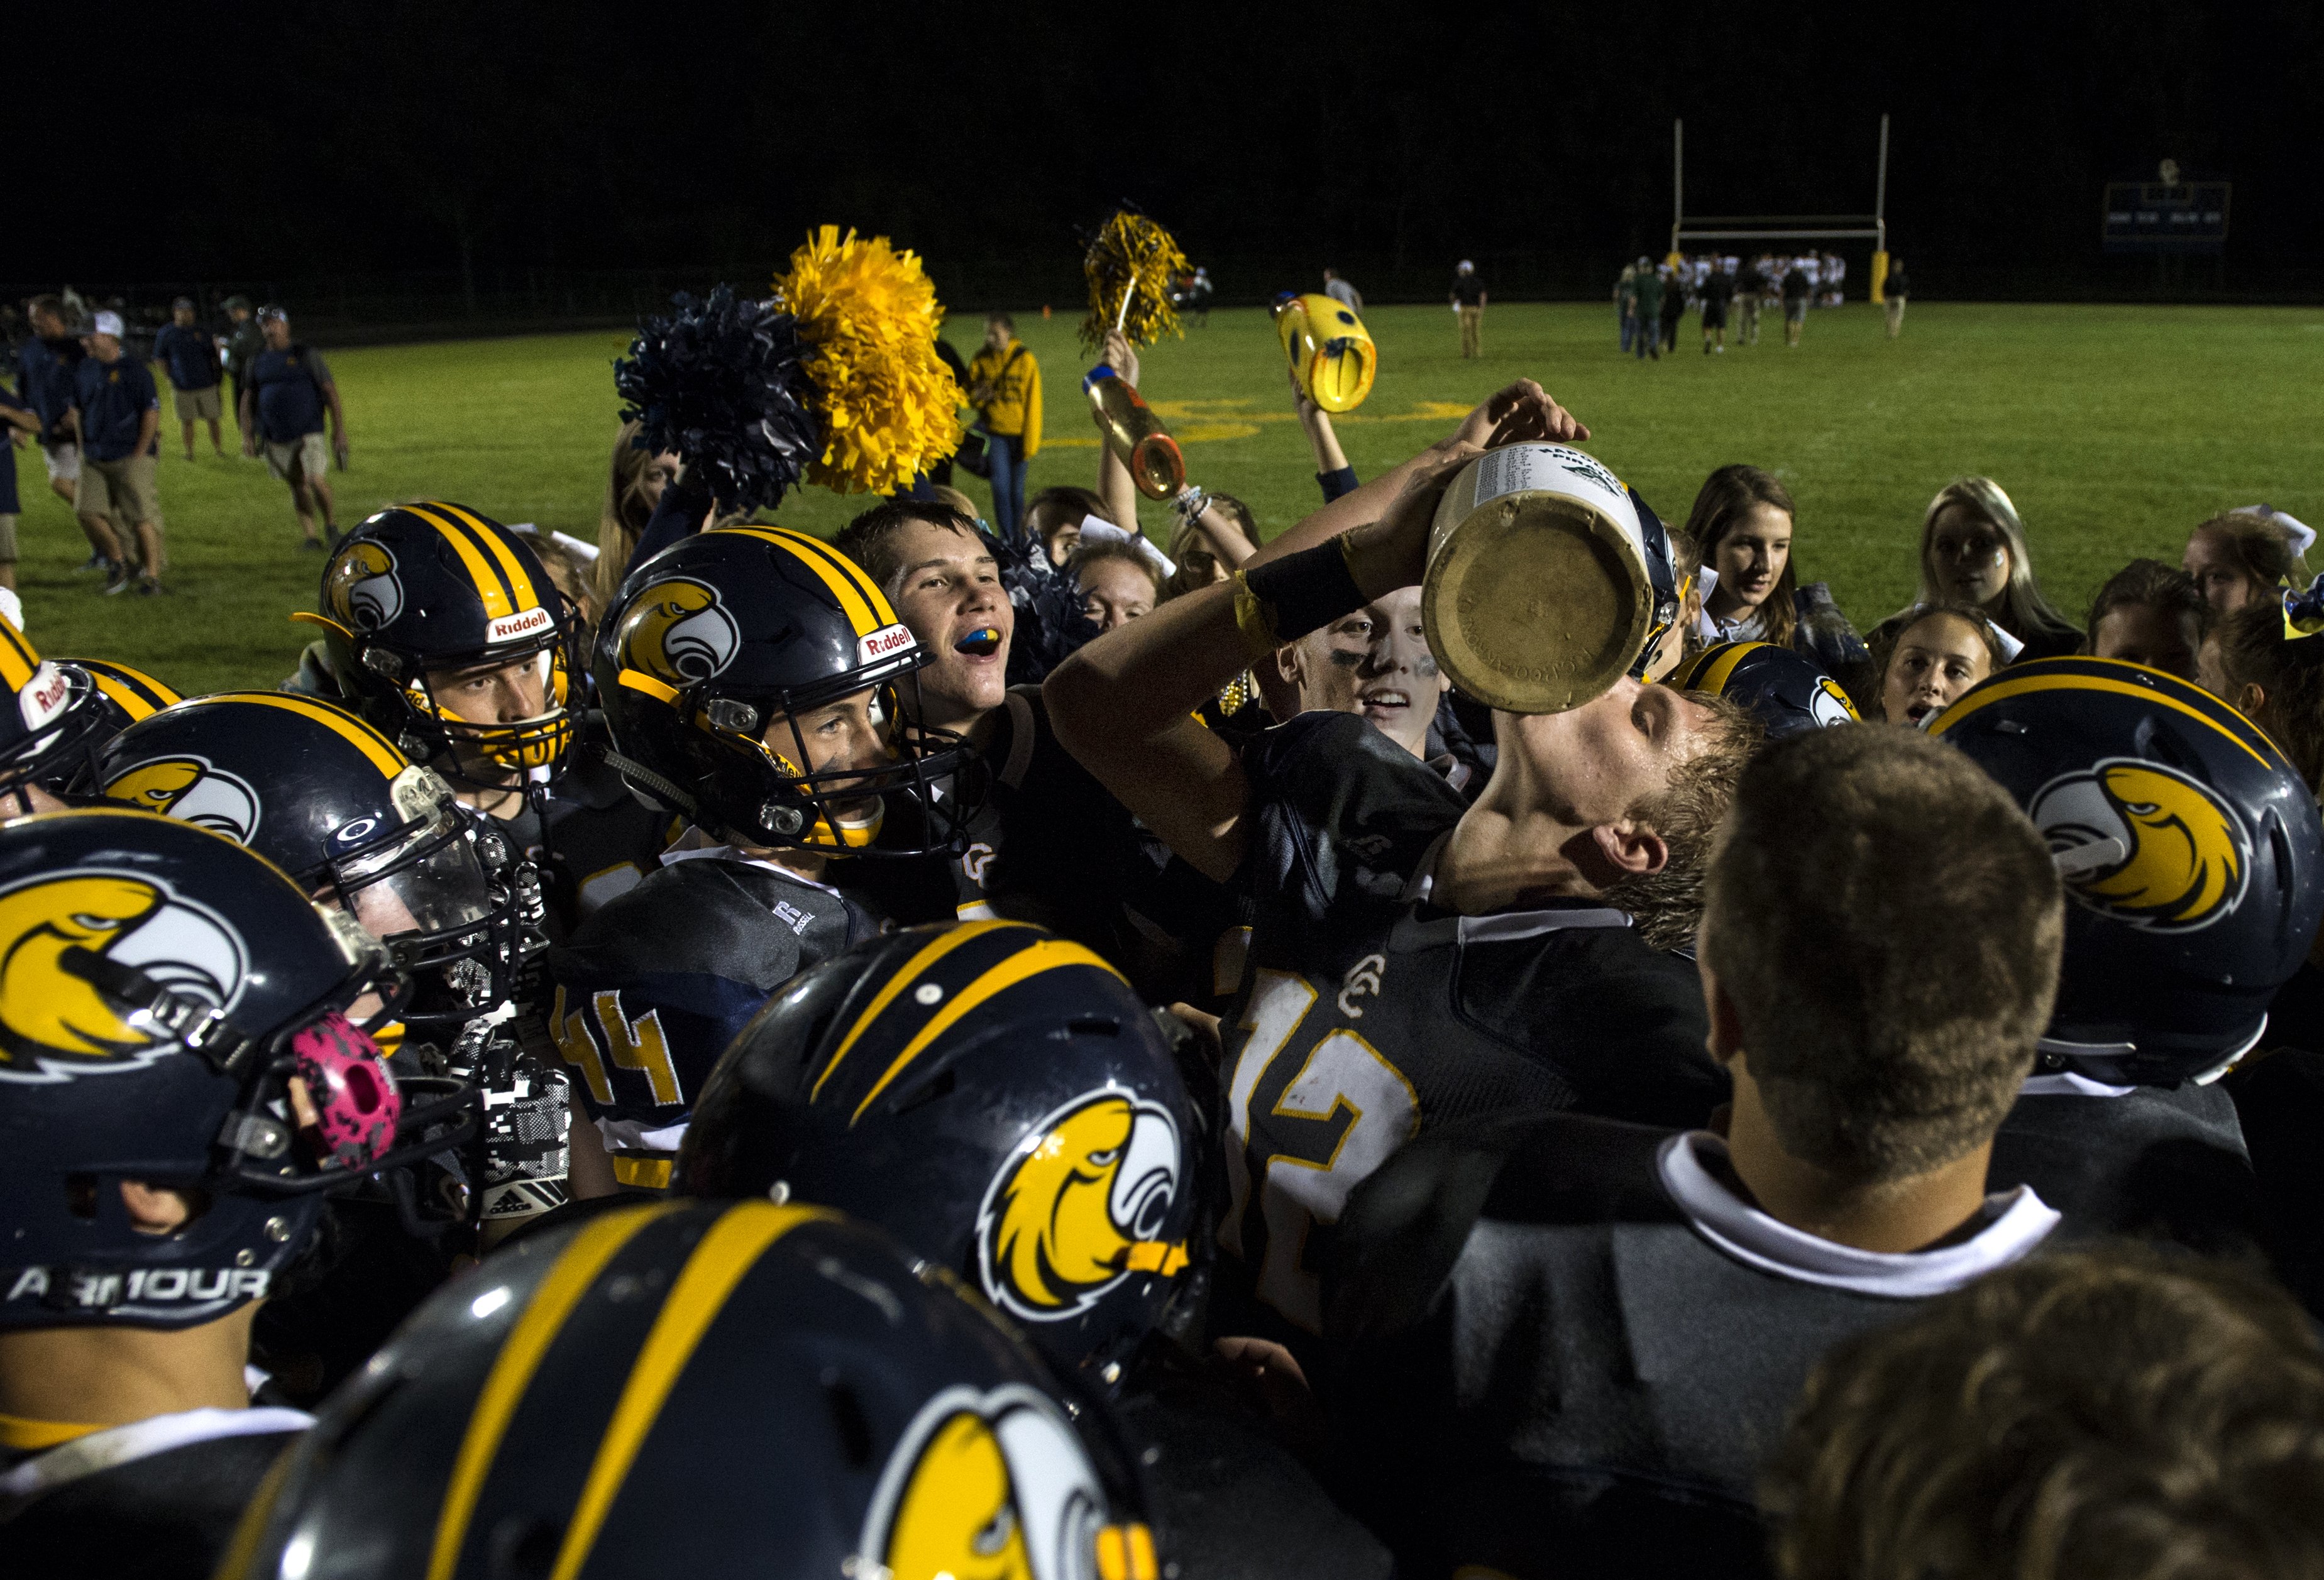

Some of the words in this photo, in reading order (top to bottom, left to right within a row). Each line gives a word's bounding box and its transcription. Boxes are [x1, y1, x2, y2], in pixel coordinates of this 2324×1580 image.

[495, 612, 546, 636] Riddell
[866, 627, 911, 656] Riddell
[549, 982, 684, 1107] 44
[490, 1203, 532, 1214] adidas
